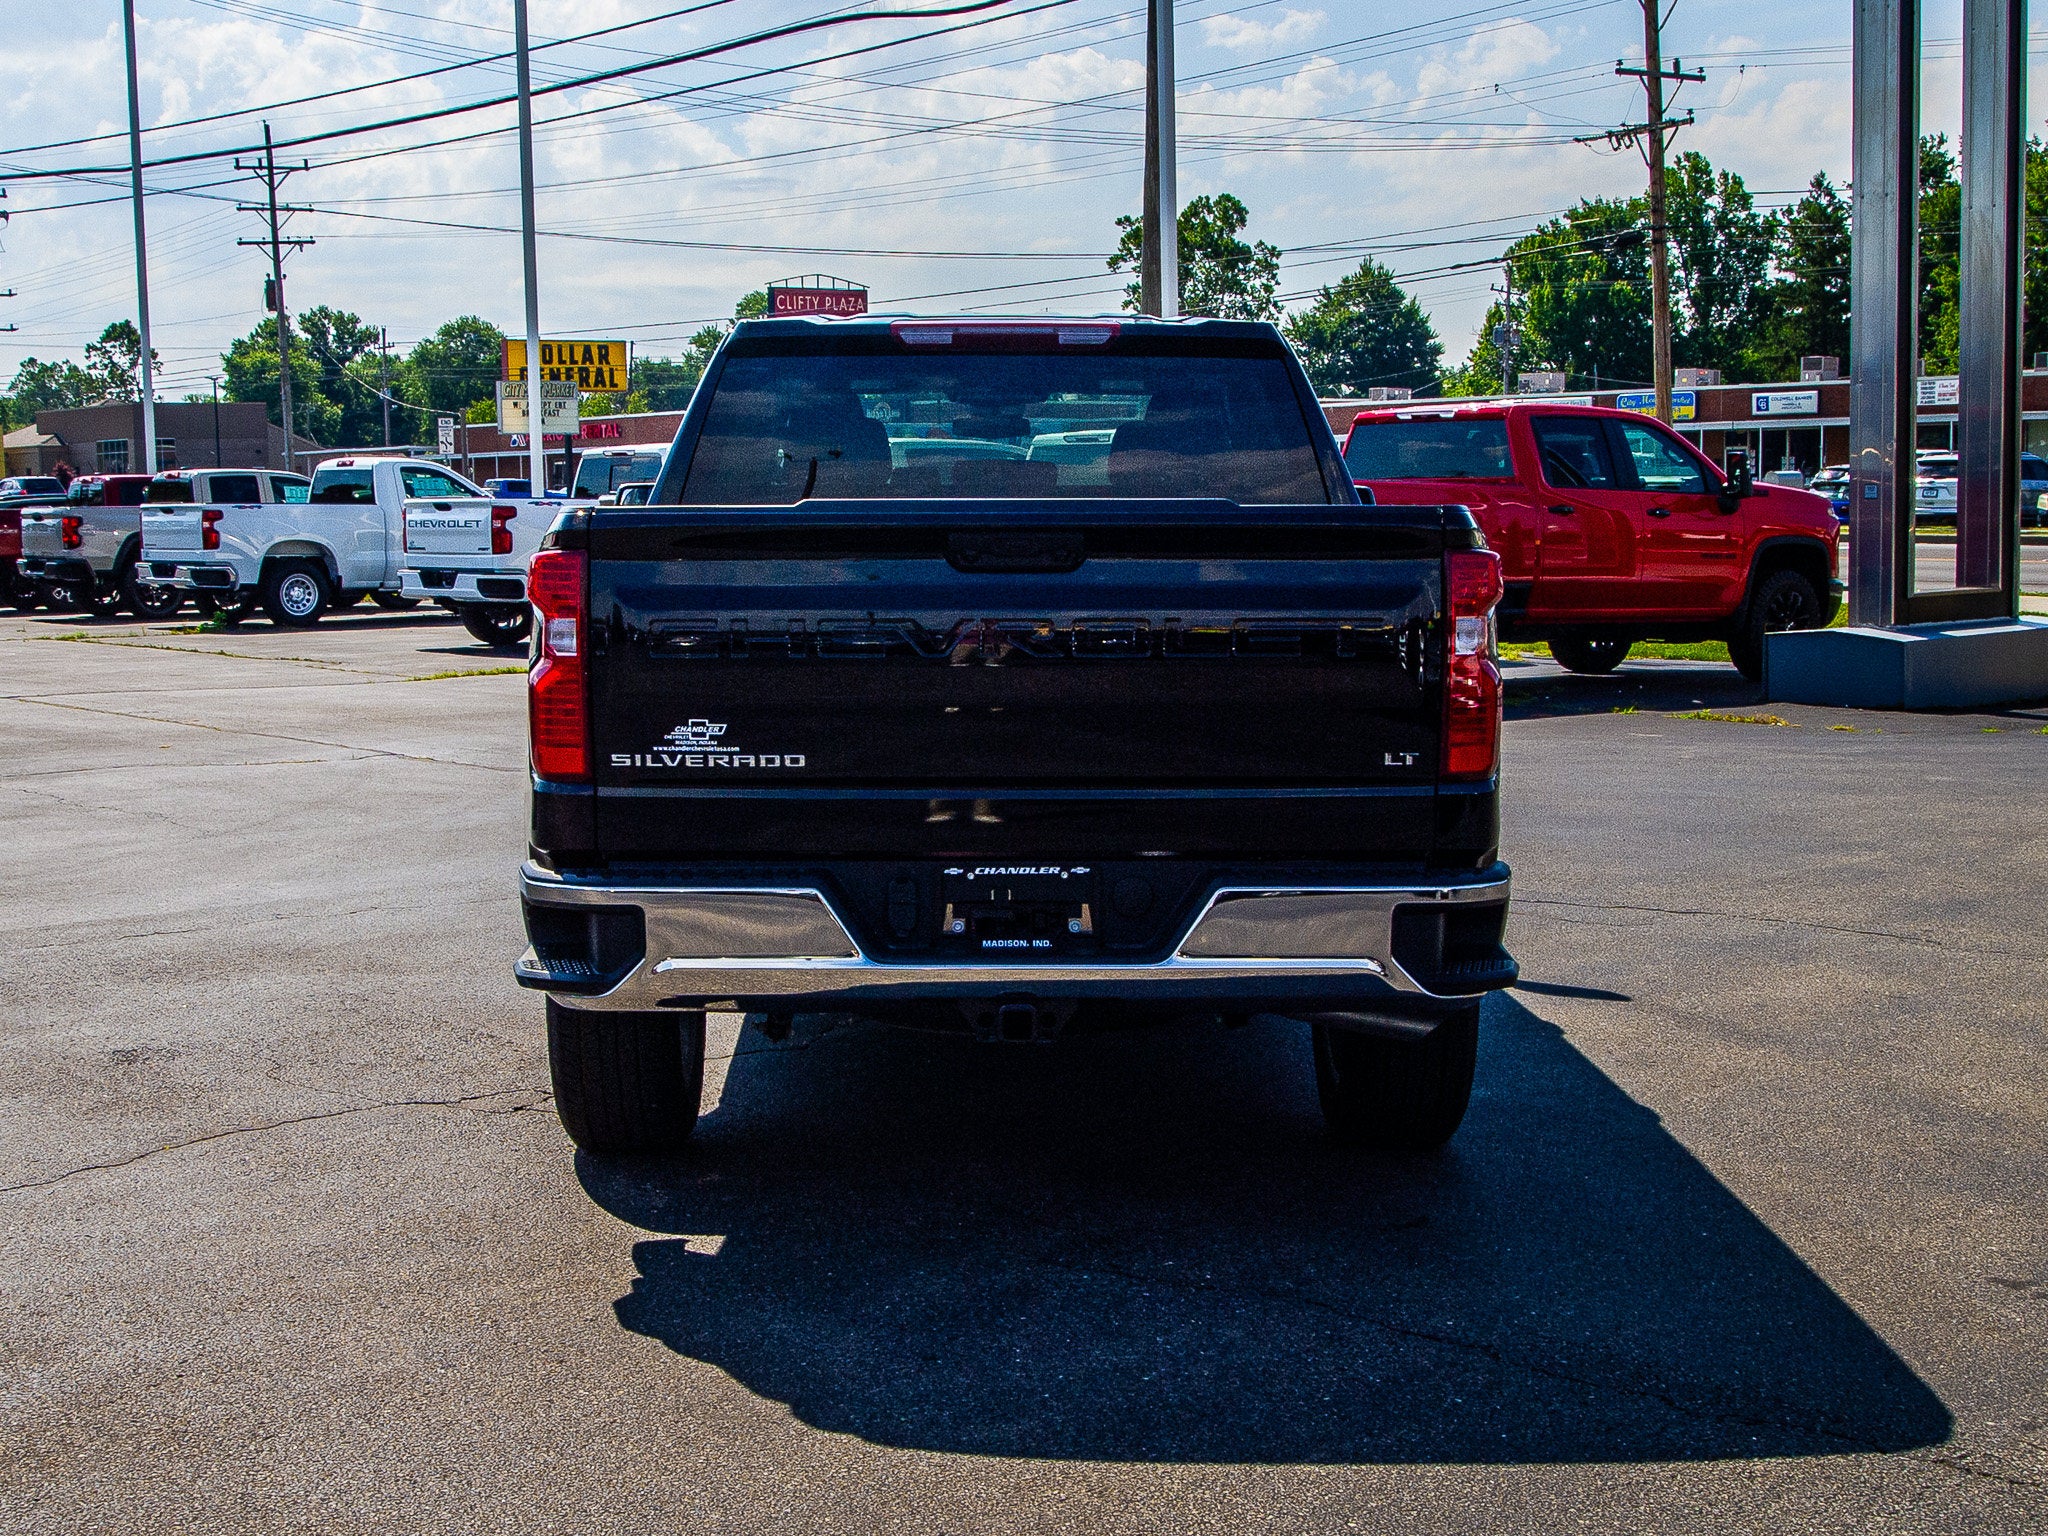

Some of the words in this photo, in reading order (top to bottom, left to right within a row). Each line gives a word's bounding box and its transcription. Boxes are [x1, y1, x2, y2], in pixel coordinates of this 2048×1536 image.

[776, 295, 820, 310] CLIFTY
[825, 296, 865, 312] PLAZA
[525, 343, 611, 365] OLLAR
[408, 519, 482, 529] CHEVROLET
[610, 754, 806, 767] SILVERADO
[1384, 752, 1420, 765] LT
[974, 867, 1061, 875] CHANDLER
[1032, 939, 1053, 948] IND.
